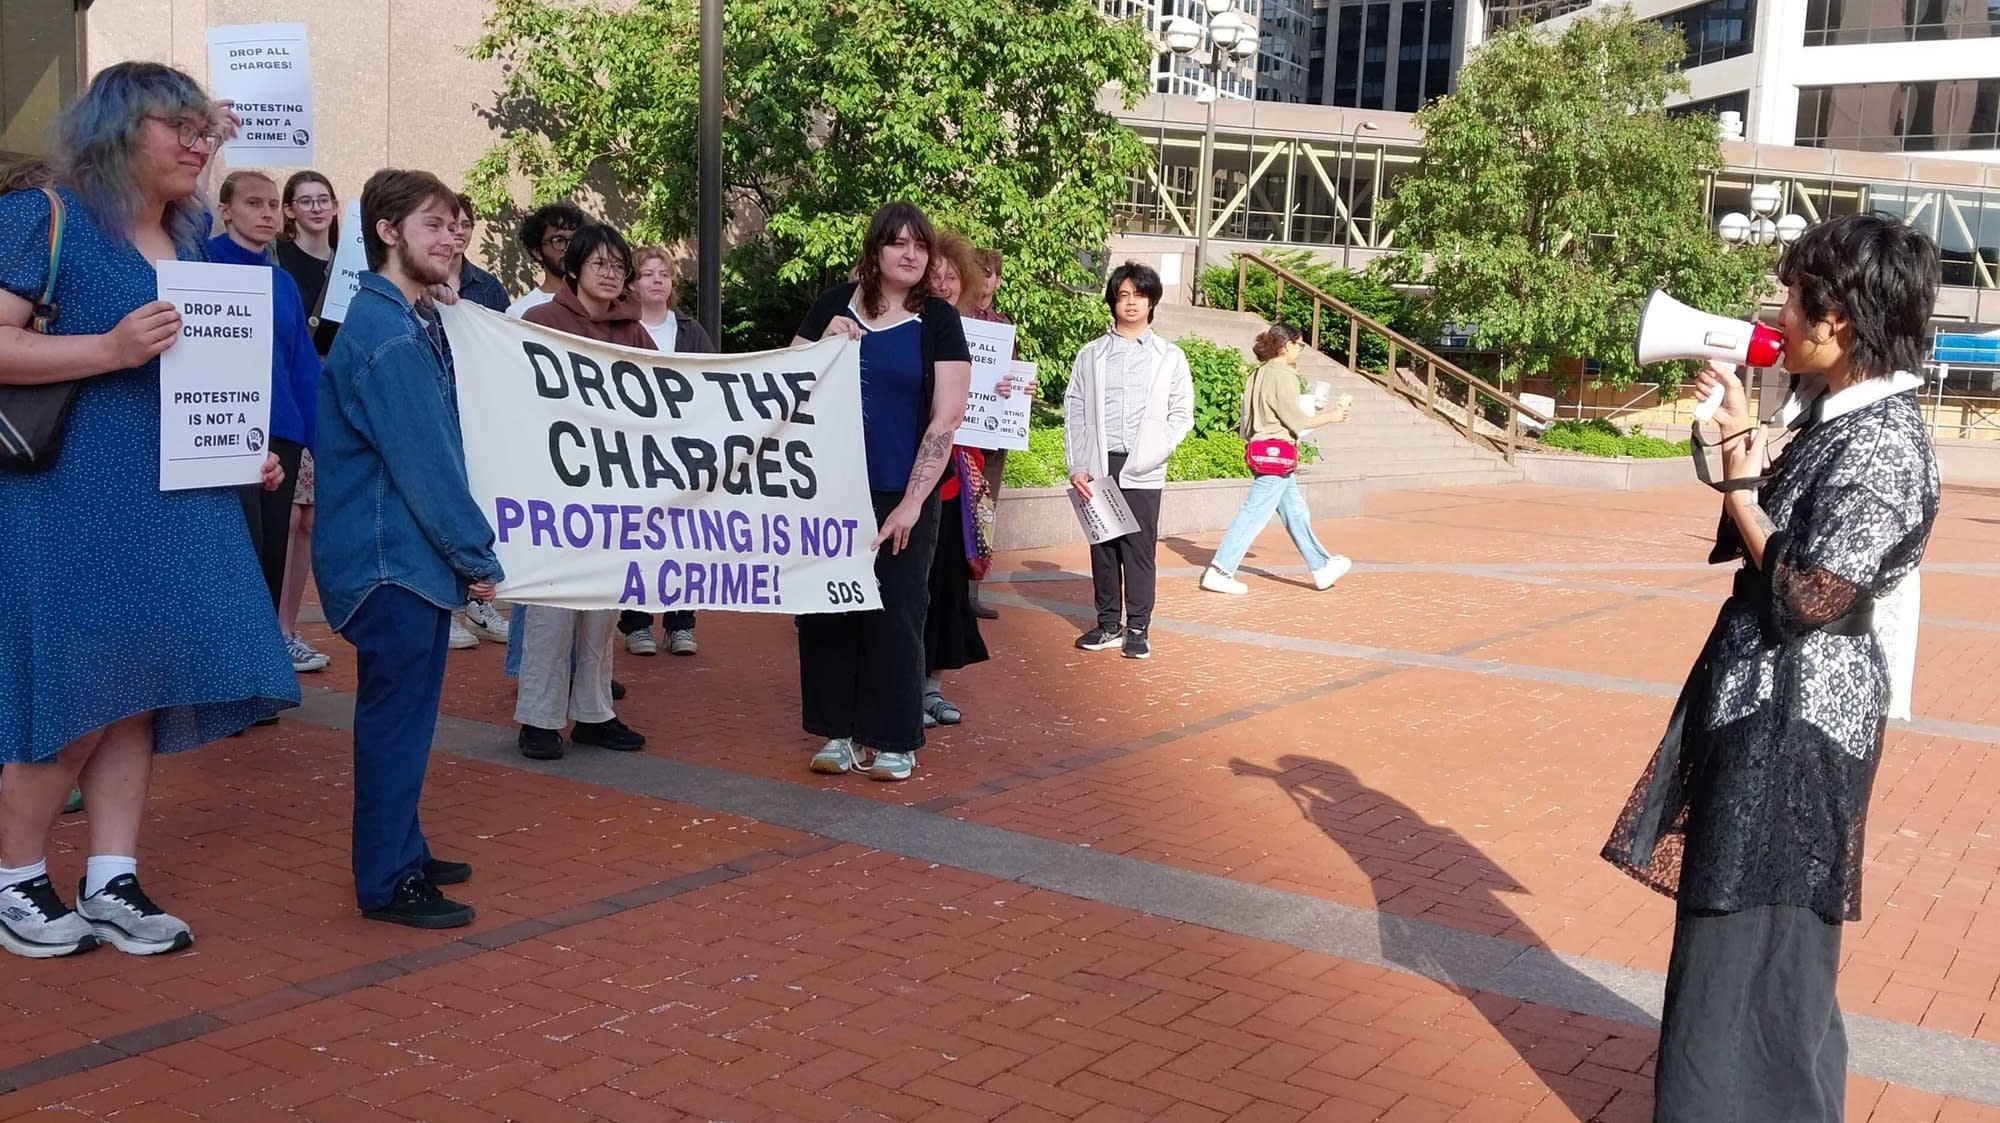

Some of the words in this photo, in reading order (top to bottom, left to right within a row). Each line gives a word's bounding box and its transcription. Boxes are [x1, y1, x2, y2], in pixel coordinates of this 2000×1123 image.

[230, 48, 262, 57] DROP
[267, 47, 290, 55] ALL
[230, 61, 292, 70] CHARGES!
[241, 118, 252, 126] IS
[256, 118, 280, 126] NOT
[246, 132, 287, 141] CRIME!
[184, 303, 222, 316] DROP
[226, 305, 252, 317] ALL
[183, 325, 253, 338] CHARGES!
[979, 343, 997, 352] ALL
[522, 341, 694, 420] DROP
[702, 371, 818, 425] THE
[174, 391, 260, 404] PROTESTING
[968, 391, 997, 402] STING
[188, 413, 202, 426] IS
[206, 413, 233, 425] NOT
[237, 412, 246, 424] A
[194, 434, 240, 447] CRIME!
[548, 420, 818, 500] CHARGES
[495, 497, 752, 553] PROTESTING
[762, 513, 791, 556] IS
[800, 516, 858, 558] NOT
[619, 560, 646, 606] A
[657, 559, 782, 608] CRIME!
[826, 580, 865, 605] SDS
